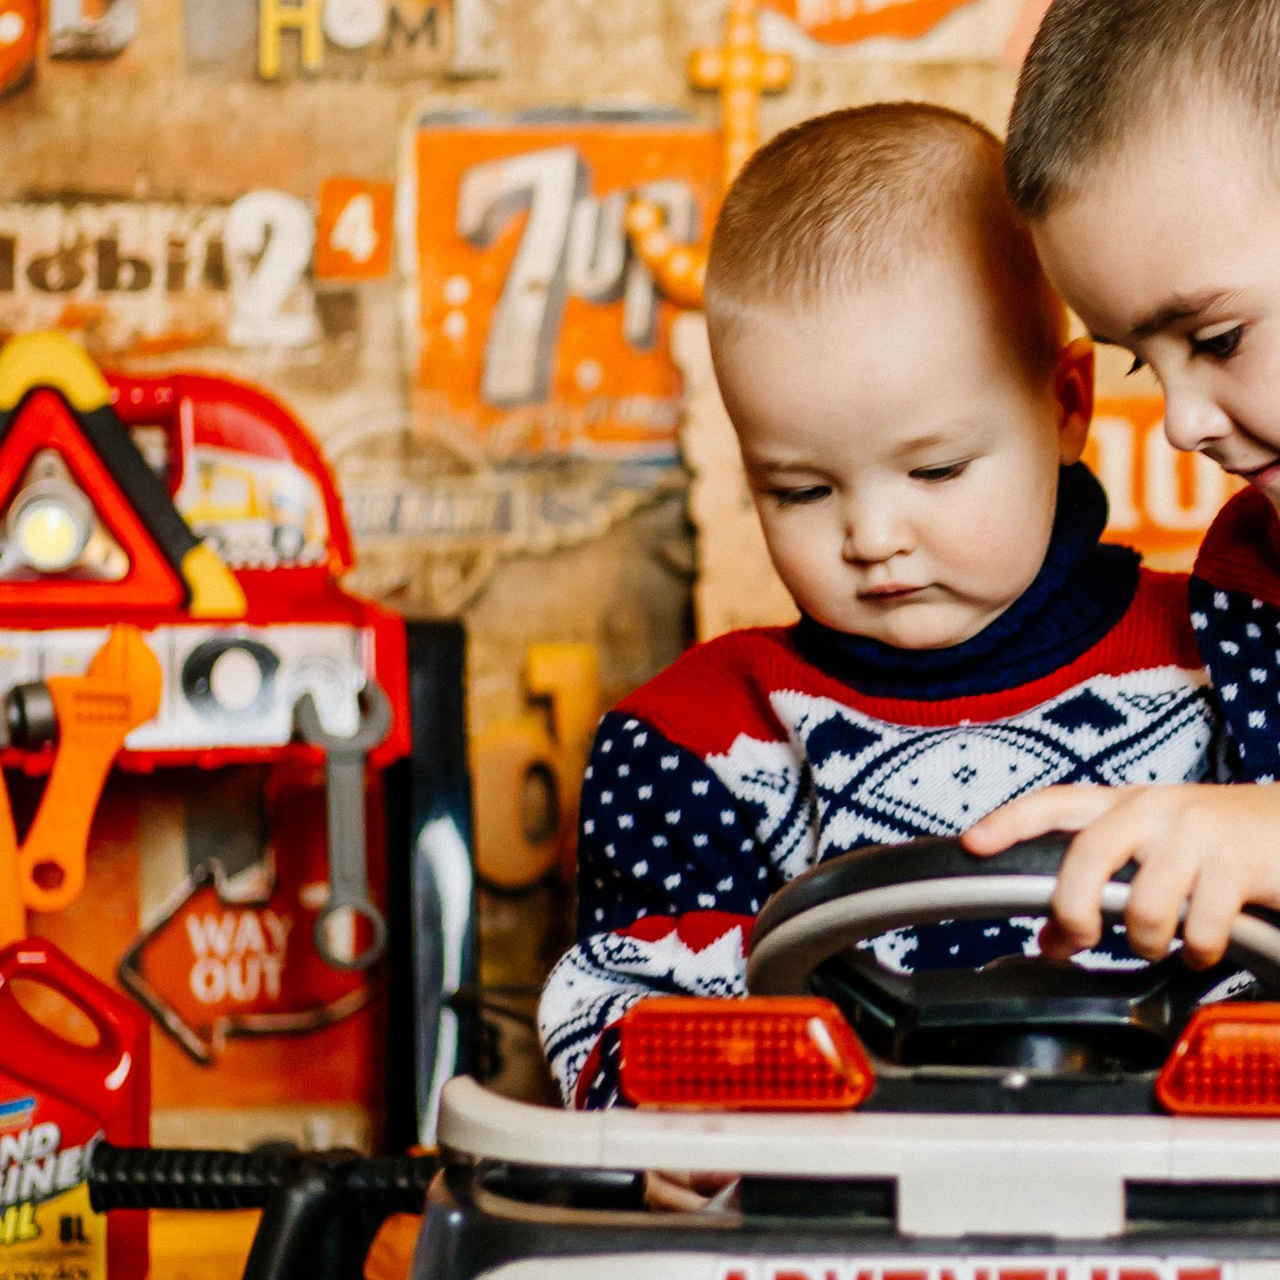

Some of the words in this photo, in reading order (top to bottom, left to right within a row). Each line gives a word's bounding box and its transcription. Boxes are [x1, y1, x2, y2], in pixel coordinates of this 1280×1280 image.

[0, 225, 228, 294] obil
[186, 910, 294, 960] WAY
[189, 952, 284, 1004] OUT
[0, 1147, 84, 1204] INE
[0, 1201, 40, 1244] IL
